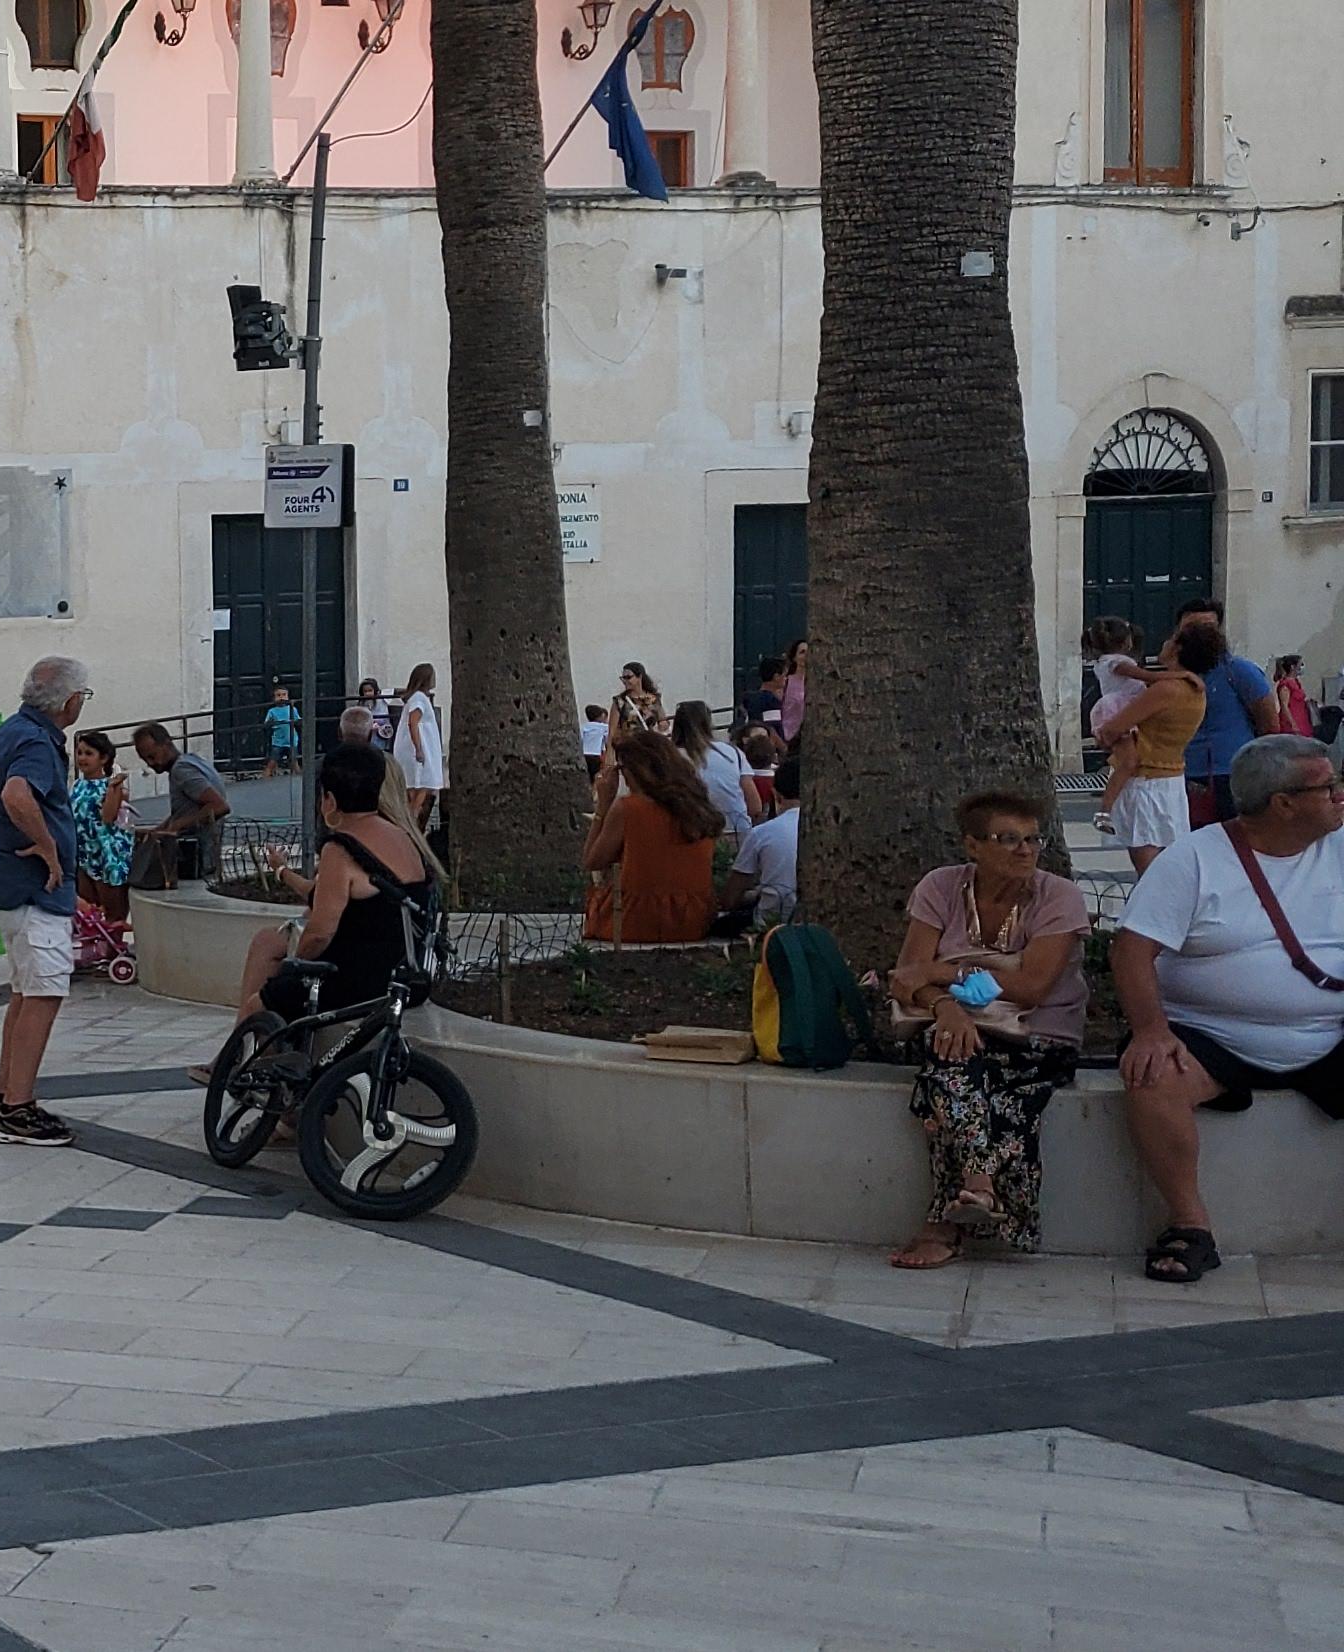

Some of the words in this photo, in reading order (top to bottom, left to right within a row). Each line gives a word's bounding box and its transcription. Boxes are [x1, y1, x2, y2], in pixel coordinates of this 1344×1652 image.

[285, 496, 310, 504] FOUR
[556, 492, 587, 504] DONIA
[285, 504, 320, 513] AGENTS
[560, 514, 599, 522] RGIMENTO
